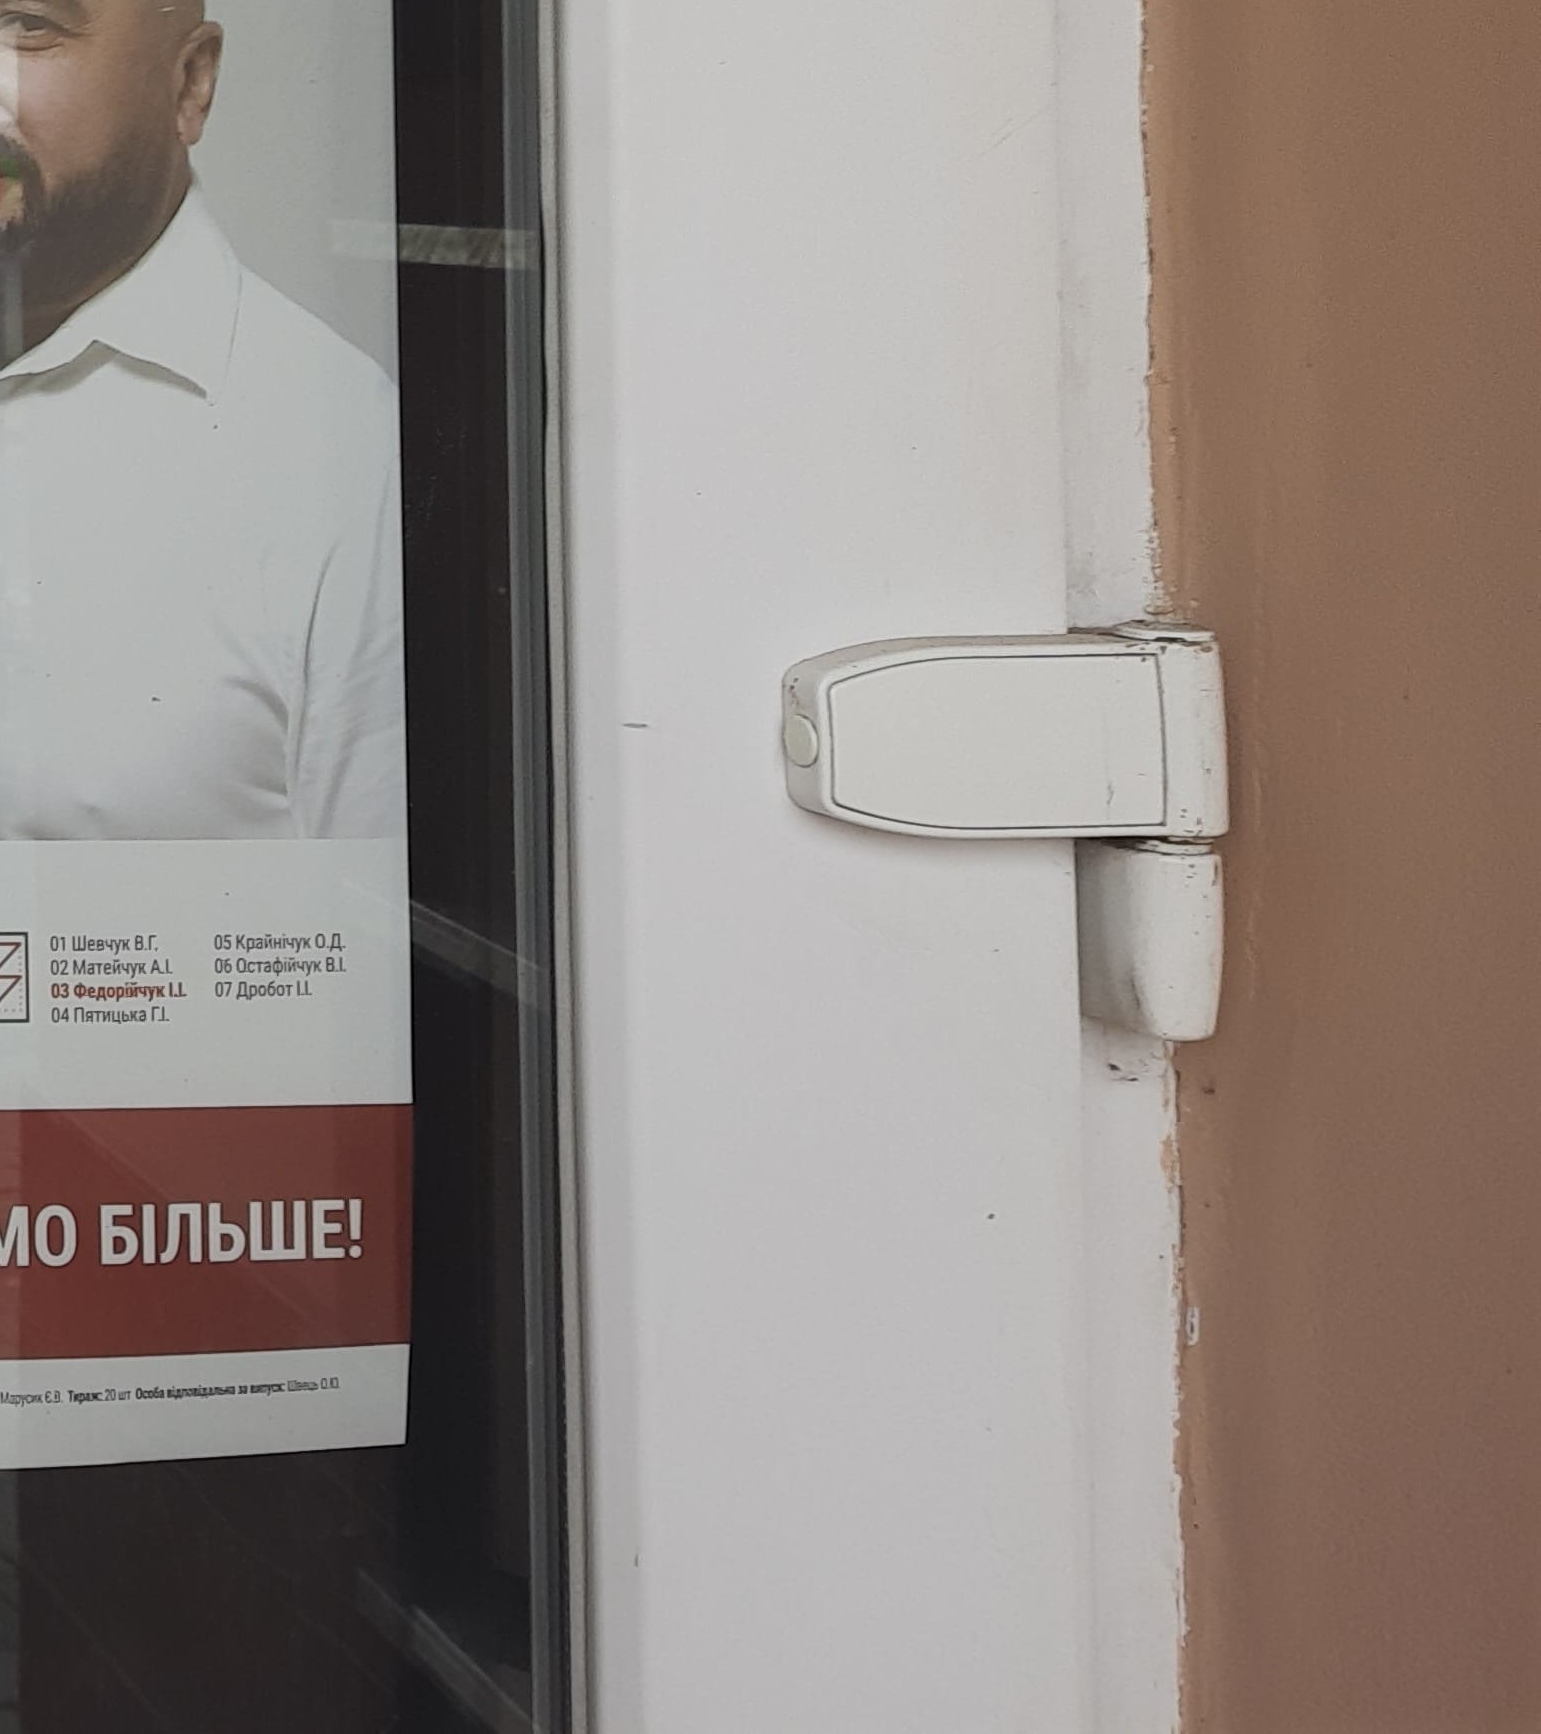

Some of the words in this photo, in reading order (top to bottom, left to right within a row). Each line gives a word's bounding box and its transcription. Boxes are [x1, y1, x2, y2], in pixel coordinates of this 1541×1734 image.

[50, 936, 67, 952] 01
[71, 934, 131, 955] Шевчук
[134, 934, 159, 952] В.Г.
[213, 933, 232, 950] 05
[235, 932, 311, 954] Крайнічук
[314, 933, 347, 952] О.Д.
[50, 959, 69, 975] 02
[72, 958, 147, 978] Матейчук
[214, 958, 232, 973] 06
[236, 956, 322, 976] Остафійчук
[51, 982, 70, 998] 03
[73, 981, 166, 1002] Федорійчук
[214, 981, 232, 997] 07
[236, 981, 293, 1000] Дробот
[51, 1007, 69, 1023] 04
[74, 1006, 147, 1024] Пятицька
[98, 1197, 366, 1269] БІЛЬШЕ!
